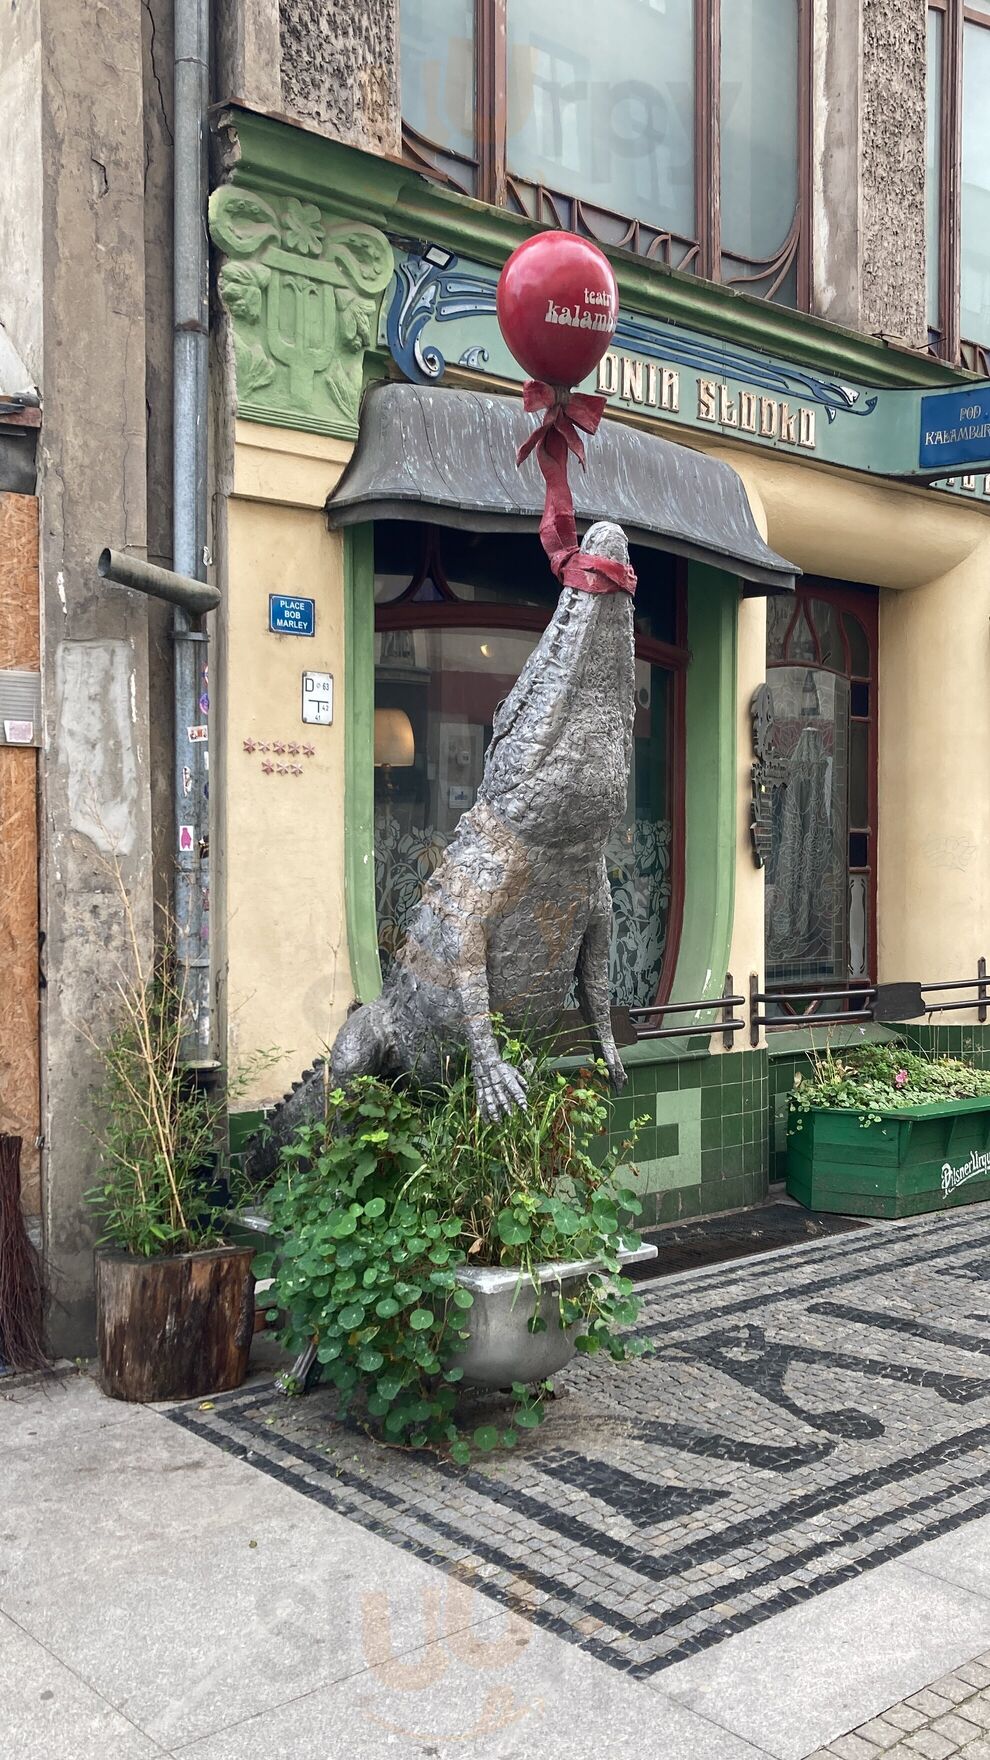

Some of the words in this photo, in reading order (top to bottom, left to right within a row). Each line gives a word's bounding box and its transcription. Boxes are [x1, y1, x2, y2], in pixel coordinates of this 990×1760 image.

[584, 288, 611, 307] teatr
[696, 377, 816, 450] SŁODKO
[960, 405, 981, 421] POD
[280, 600, 305, 611] PLACE
[284, 610, 301, 620] BOB
[276, 618, 308, 630] MARLEY
[305, 677, 314, 692] D
[941, 1162, 972, 1200] Pilsner
